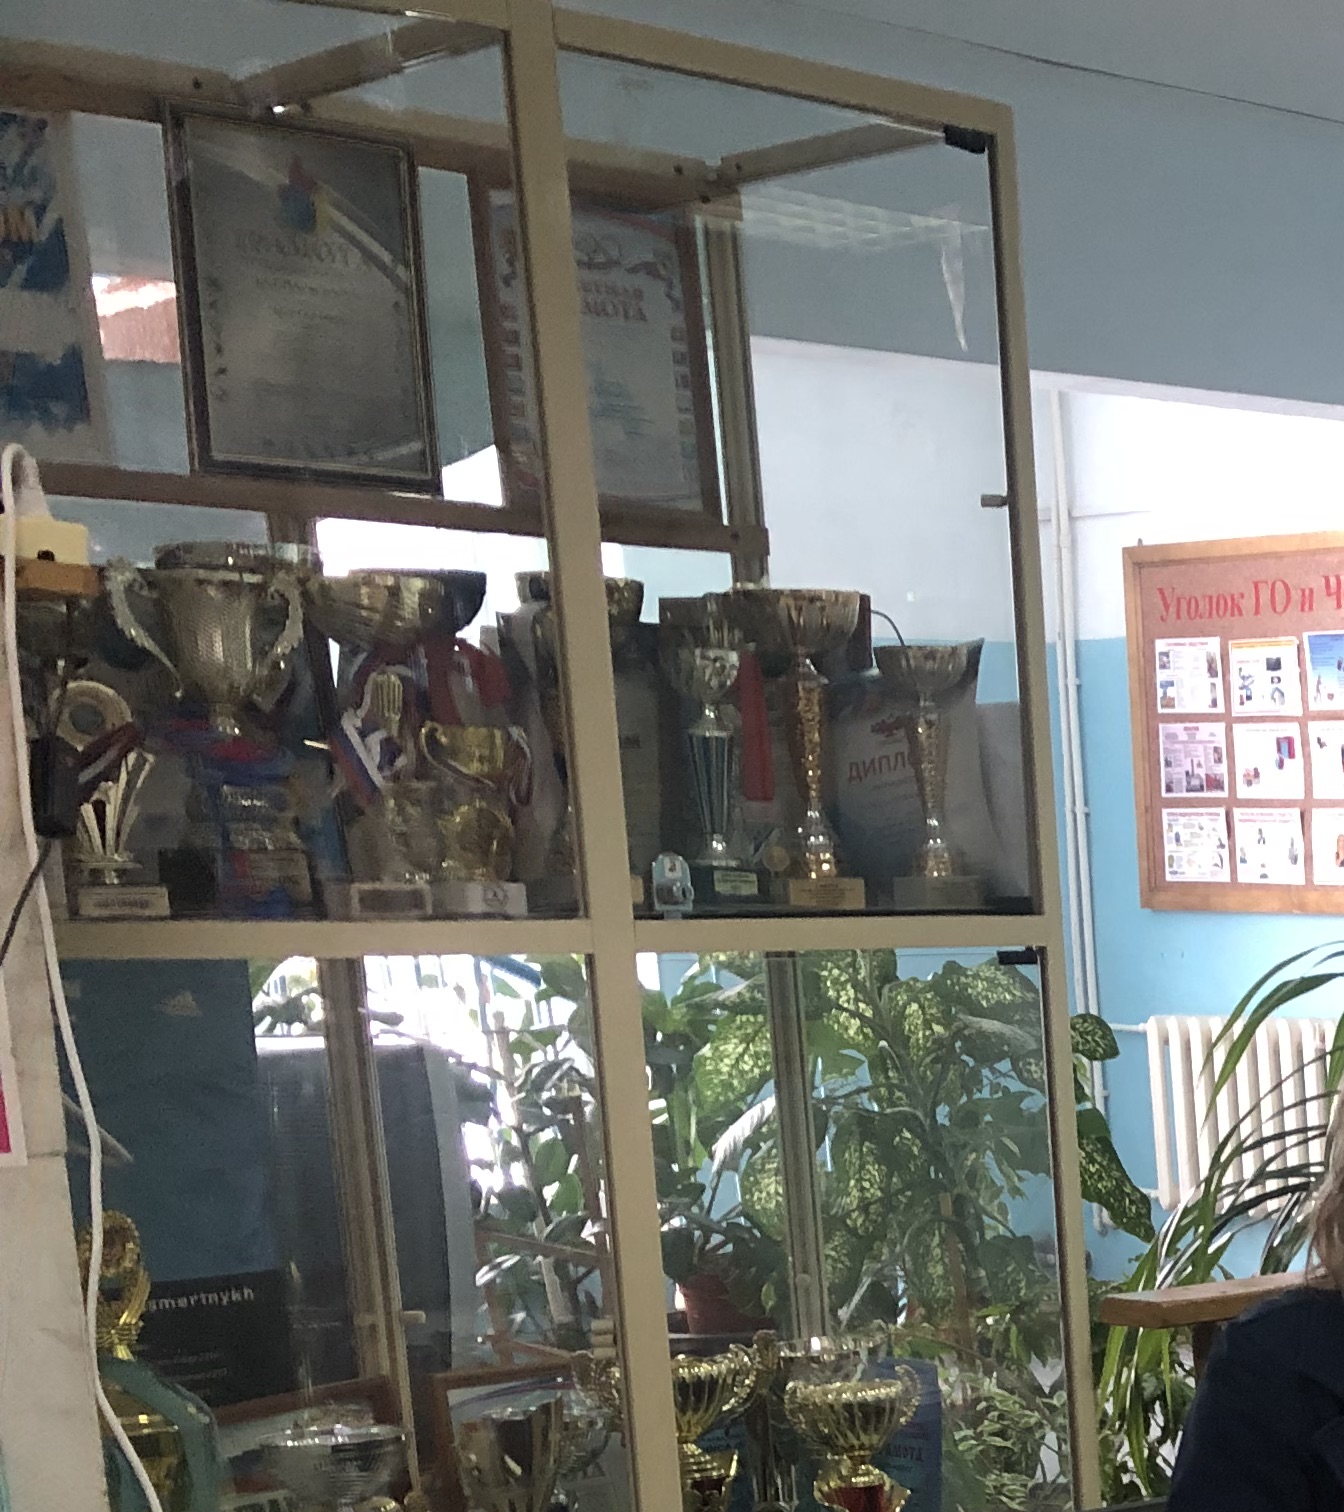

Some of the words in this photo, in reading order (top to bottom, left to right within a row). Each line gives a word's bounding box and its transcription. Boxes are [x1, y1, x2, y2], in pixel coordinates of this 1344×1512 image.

[1156, 586, 1246, 624] Уголок
[1251, 577, 1294, 617] ГО
[1299, 586, 1315, 612] и
[848, 751, 910, 784] ДИПЛ
